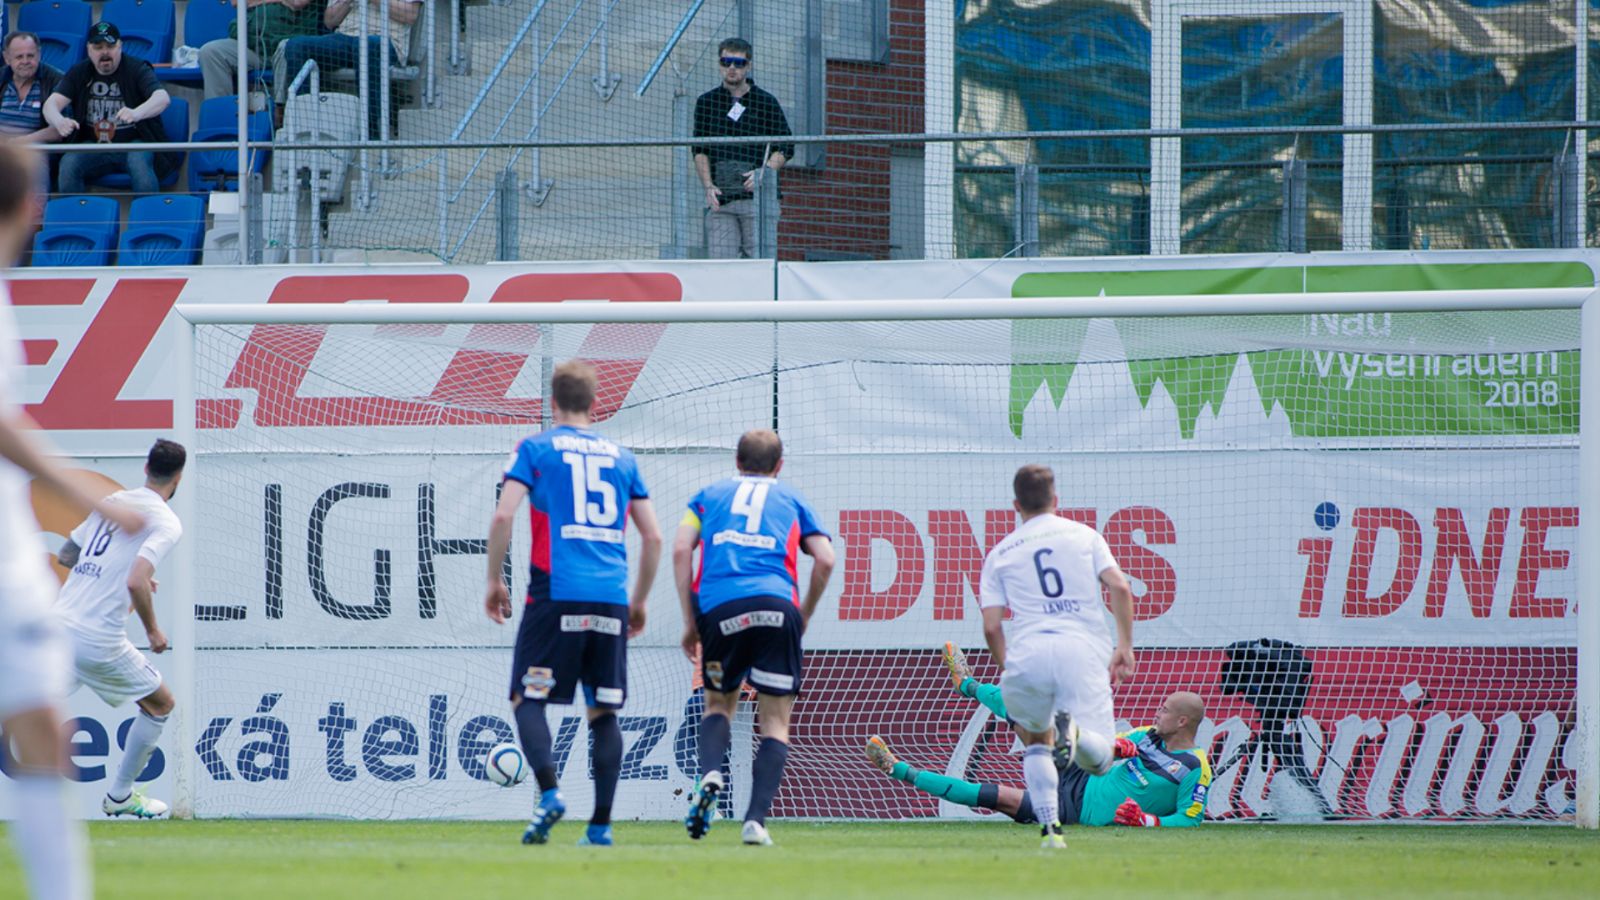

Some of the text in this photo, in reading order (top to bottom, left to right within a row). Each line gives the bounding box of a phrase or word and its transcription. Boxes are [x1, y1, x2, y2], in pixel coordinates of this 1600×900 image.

[1484, 381, 1558, 408] 2008
[562, 451, 618, 527] 15
[730, 481, 770, 533] 4
[85, 516, 120, 557] 18
[1297, 501, 1580, 619] iDNE
[838, 505, 1177, 621] DNS
[1033, 547, 1064, 599] 6
